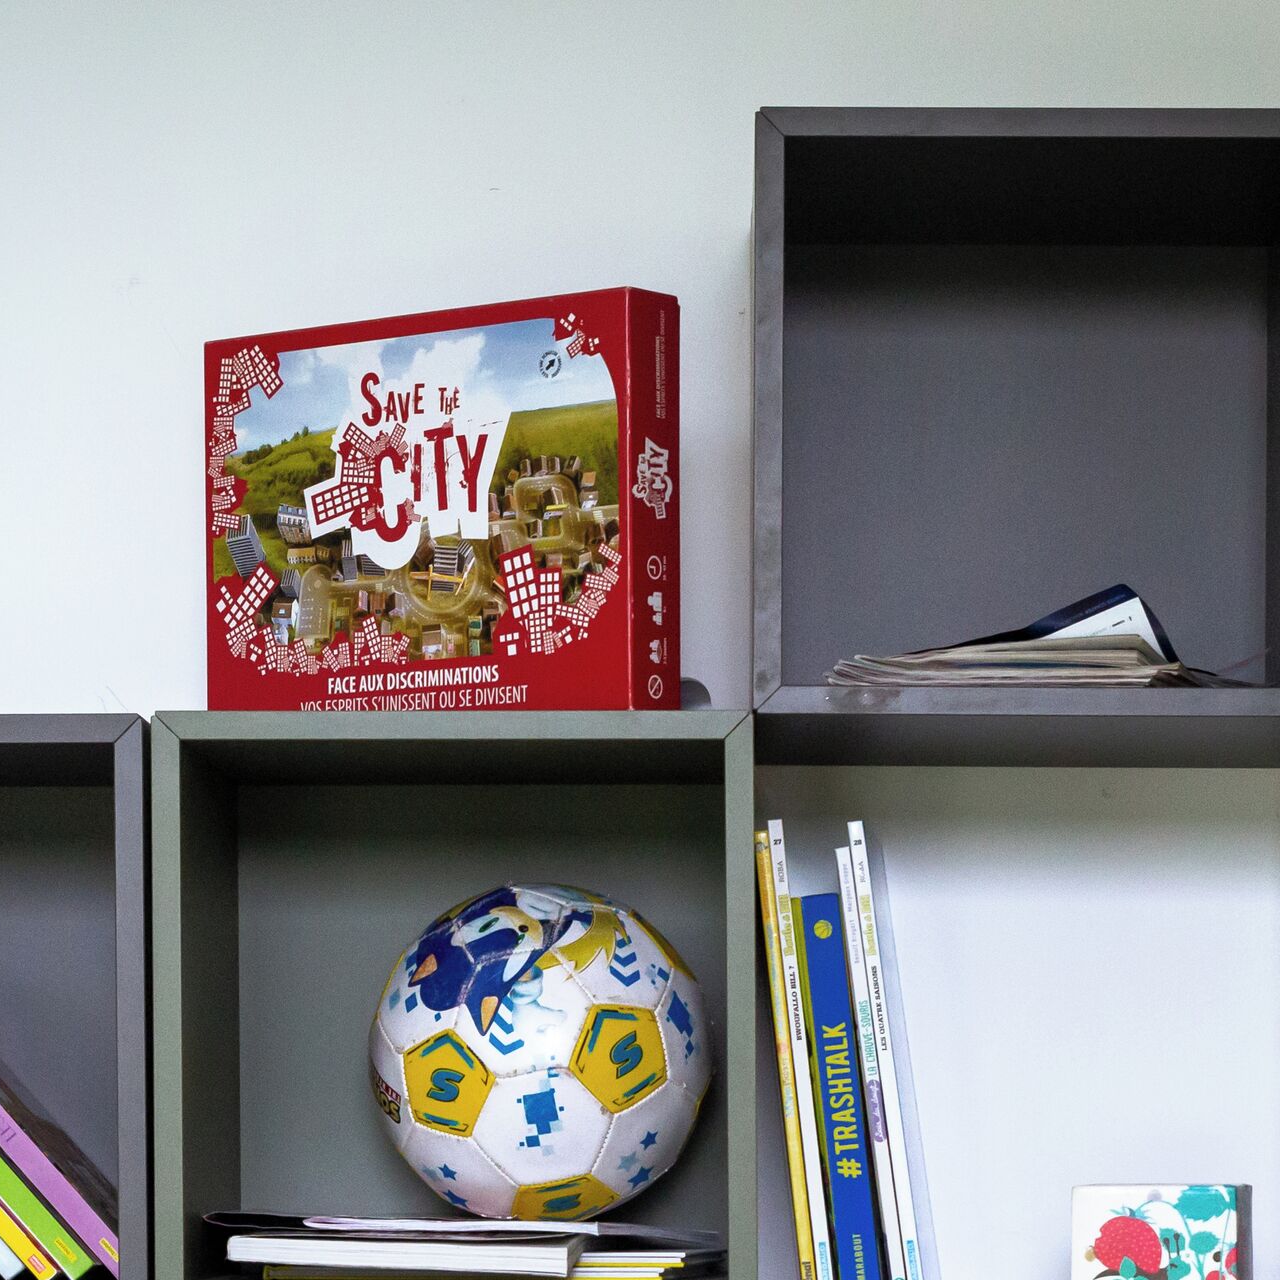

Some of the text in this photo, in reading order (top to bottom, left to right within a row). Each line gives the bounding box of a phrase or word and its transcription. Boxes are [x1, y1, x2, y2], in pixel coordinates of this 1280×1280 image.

[361, 372, 460, 426] SAVE THE
[375, 425, 488, 542] CITY
[328, 665, 499, 694] FACE AUX DISCRIMINATIONS
[372, 692, 436, 711] S'UNISSENT
[439, 690, 456, 708] OU
[459, 688, 472, 707] SE
[475, 685, 528, 705] DIVISENT
[872, 966, 881, 1000] SAISONS
[859, 1000, 877, 1067] CHAUVE-SOURIS
[877, 1002, 886, 1035] QUATRE
[610, 1033, 643, 1077] S
[428, 1069, 464, 1102] S
[822, 1021, 862, 1178] #TRASHTALK
